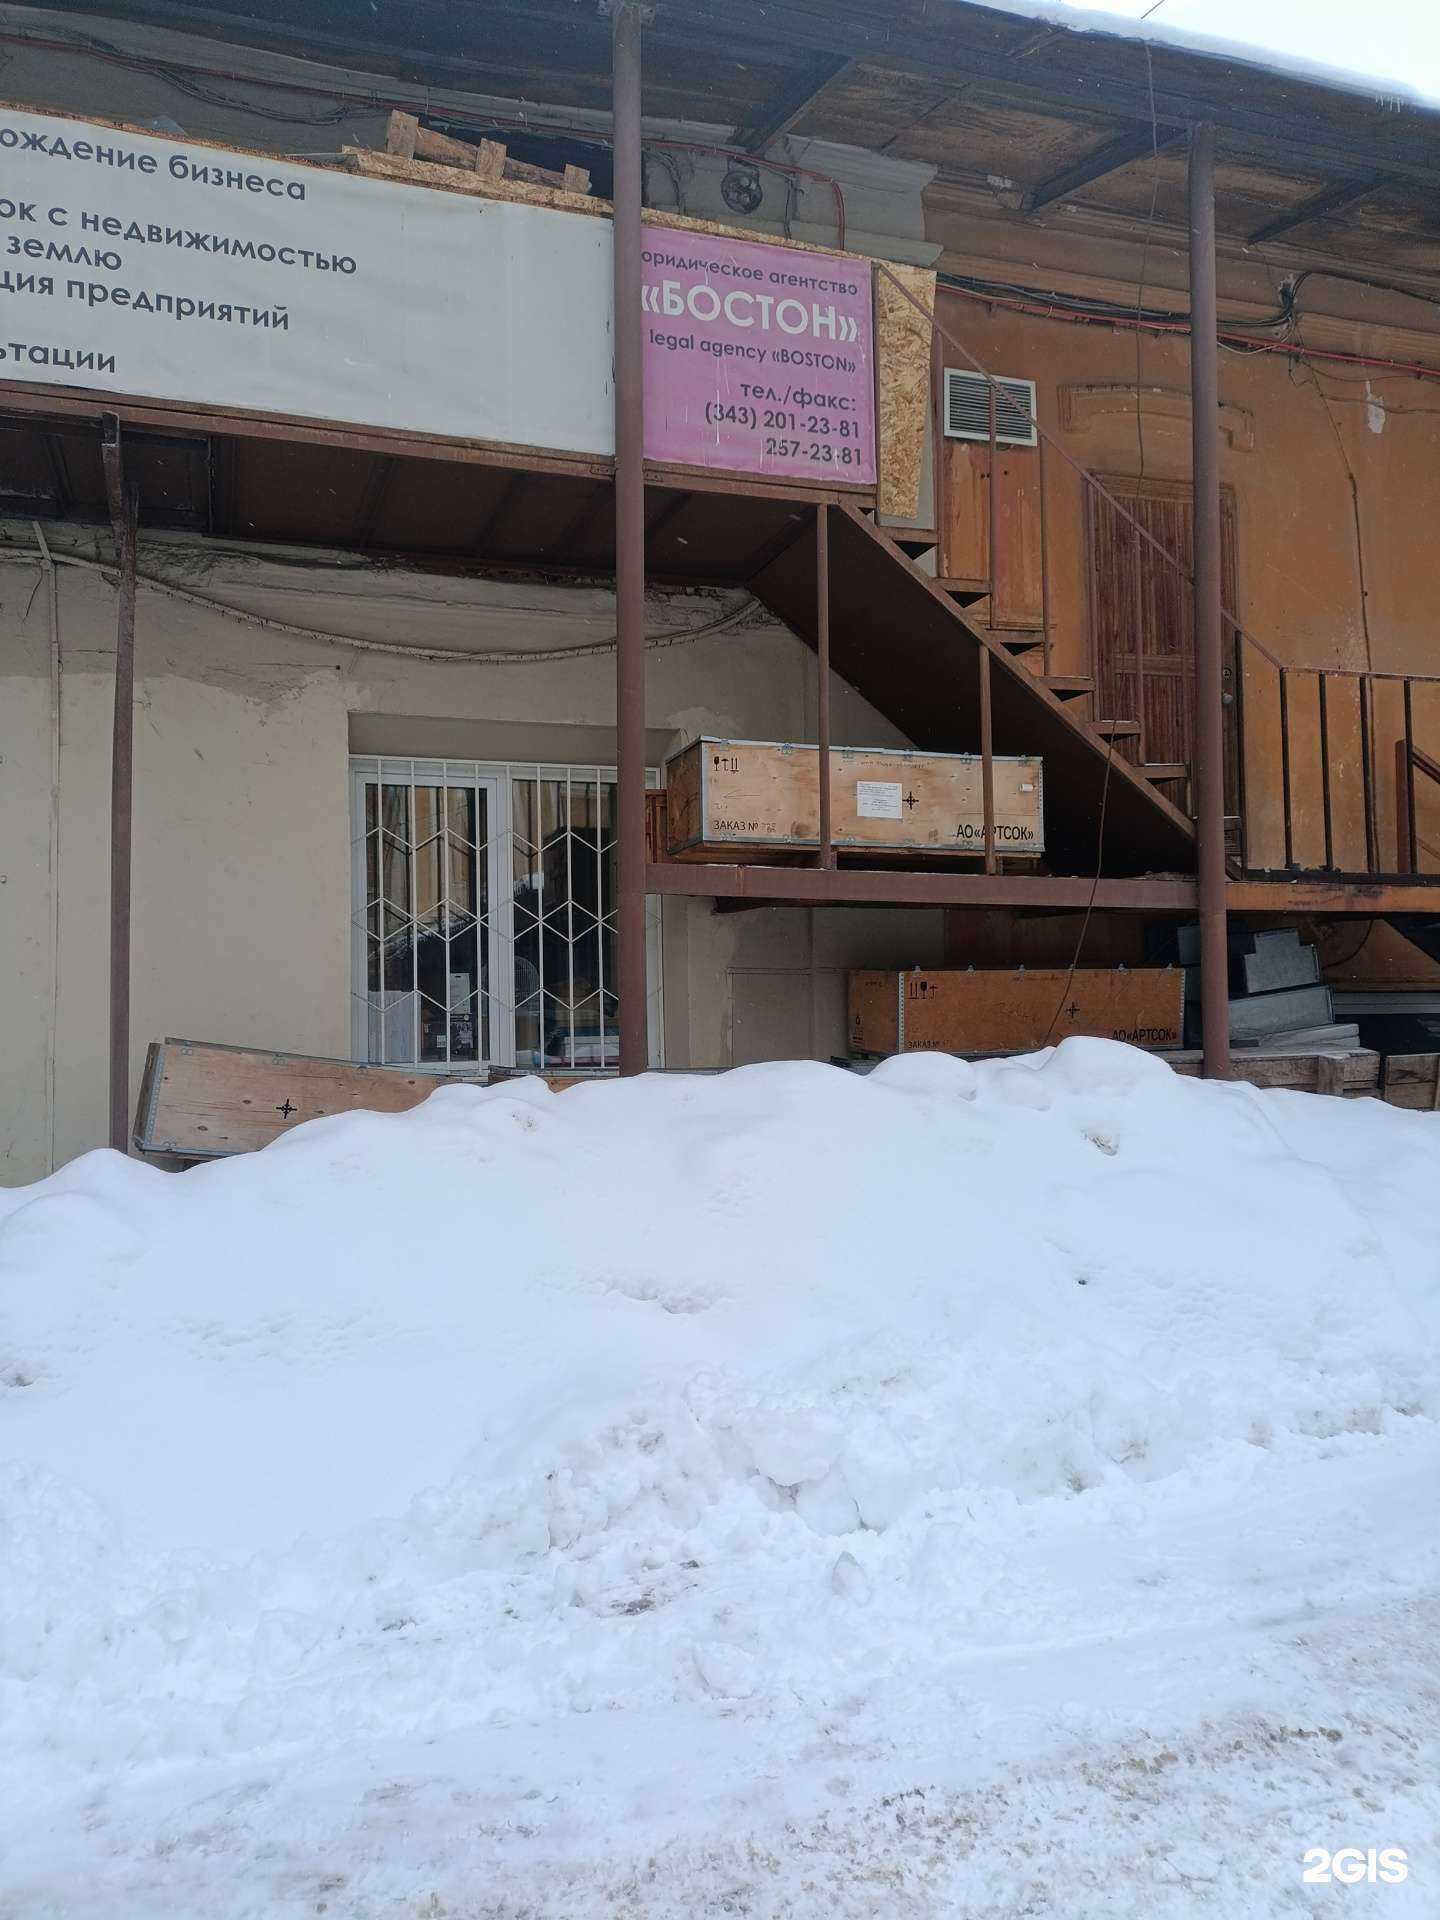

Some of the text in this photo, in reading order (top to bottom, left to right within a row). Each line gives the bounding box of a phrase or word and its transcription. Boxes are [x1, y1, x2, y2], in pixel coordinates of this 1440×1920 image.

[169, 154, 306, 201] бизнеса
[6, 236, 122, 271] землю
[48, 207, 68, 226] с
[81, 211, 357, 275] недвижимостью
[769, 273, 858, 295] агентство
[67, 280, 289, 331] предприятий
[641, 280, 858, 342] «БОСТОН»
[649, 329, 856, 373] legal agency «BOSTON»
[740, 383, 857, 411] тел./факс:
[704, 401, 859, 438] (343) 201-23-81
[713, 820, 746, 831] ЗАКАЗ
